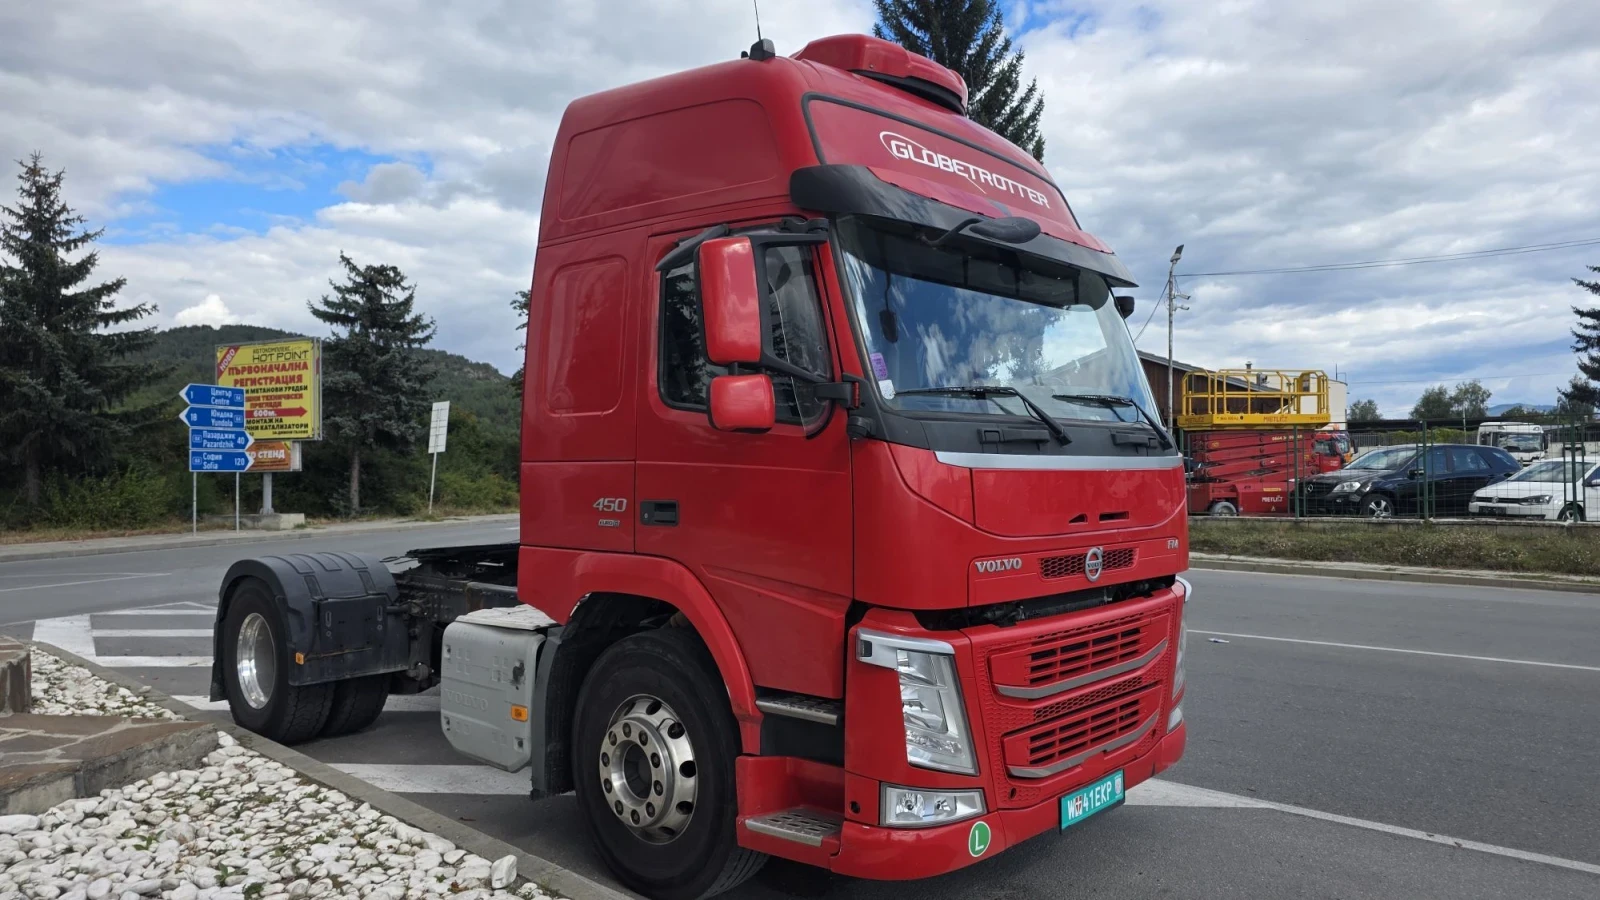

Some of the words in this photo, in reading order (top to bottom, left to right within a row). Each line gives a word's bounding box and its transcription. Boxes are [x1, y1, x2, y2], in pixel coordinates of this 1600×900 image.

[890, 140, 1050, 208] GLOBETROTTER
[220, 348, 235, 372] НОВО
[253, 353, 274, 363] HOT
[276, 350, 309, 361] POINT
[228, 361, 308, 376] ПЪРВОНАЧАЛНА
[233, 374, 303, 387] РЕГИСТРАЦИЯ
[284, 385, 308, 393] УРЕДБИ
[211, 397, 230, 405] Centre
[190, 413, 198, 421] 18
[210, 409, 233, 418] Юндола
[211, 419, 233, 427] Yundola
[260, 423, 309, 431] КАТАЛИЗАТОРИ
[202, 430, 236, 440] Пазарджик
[202, 439, 234, 448] Pazardzhik
[237, 437, 245, 445] 40
[202, 452, 222, 461] София
[258, 449, 285, 460] СТЕНД
[202, 461, 218, 470] Sofia
[234, 458, 245, 466] 120
[592, 497, 627, 512] 450
[975, 557, 1022, 573] VOLVO
[1067, 798, 1076, 820] W
[1083, 780, 1112, 812] 41EKP
[975, 829, 984, 851] L
